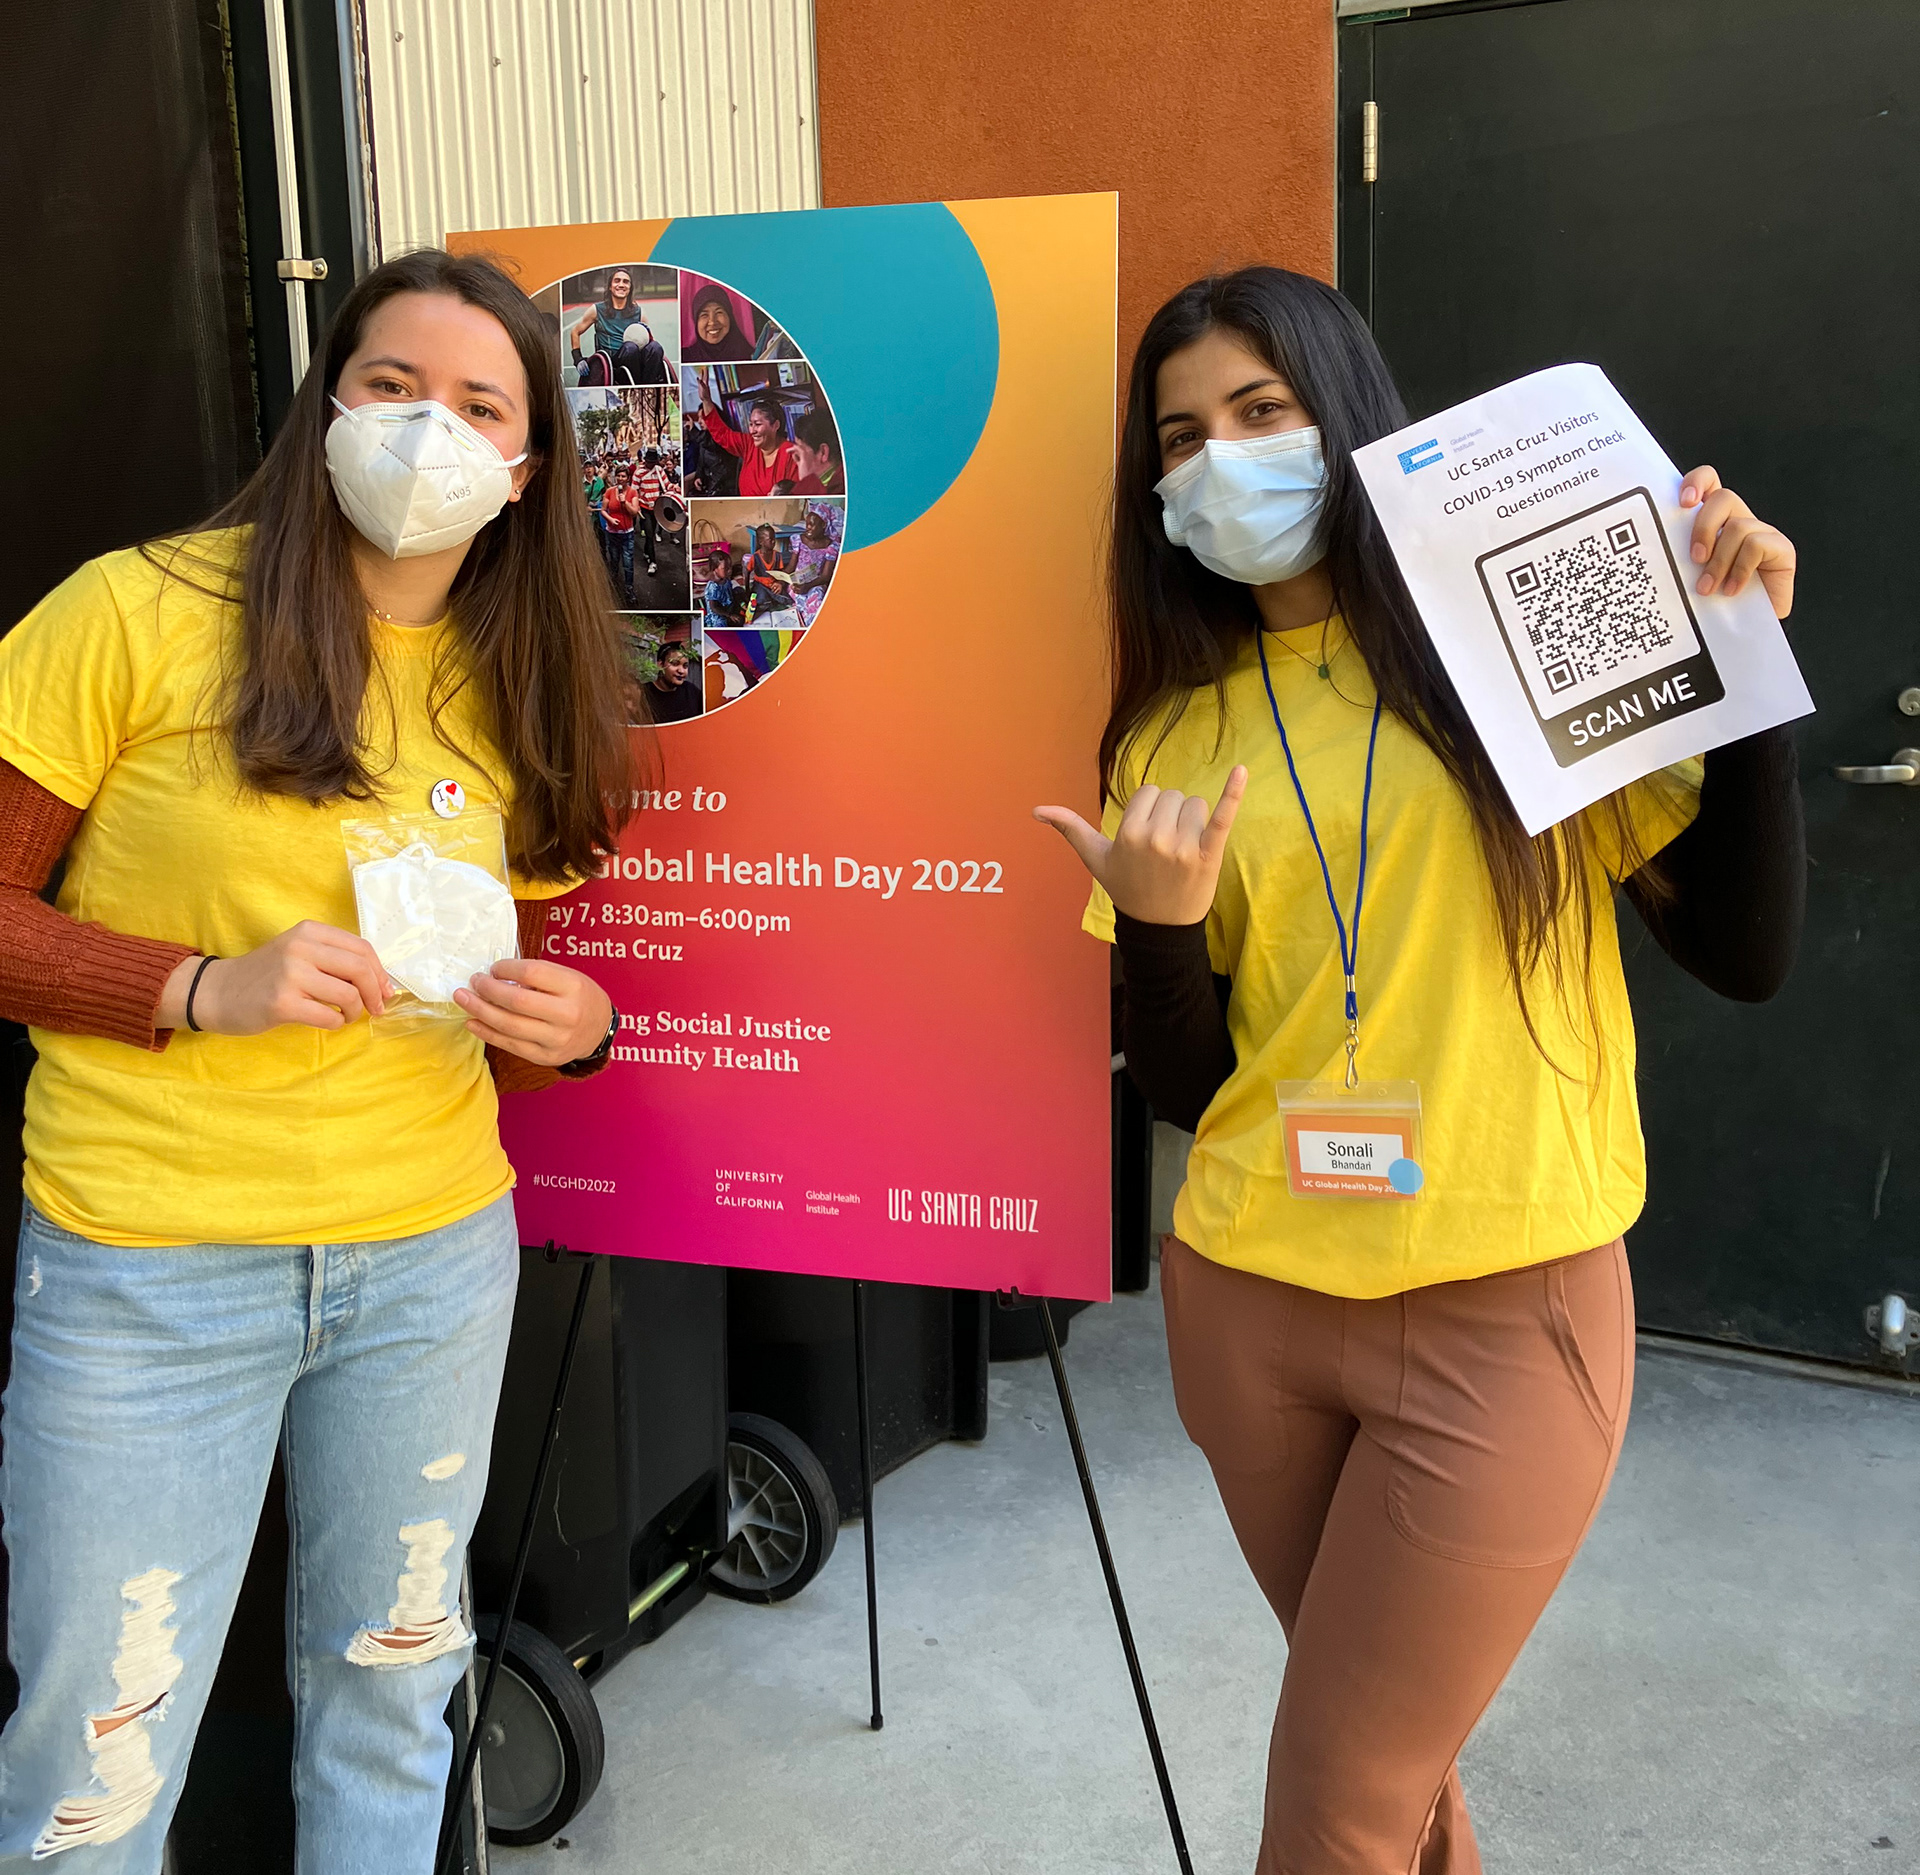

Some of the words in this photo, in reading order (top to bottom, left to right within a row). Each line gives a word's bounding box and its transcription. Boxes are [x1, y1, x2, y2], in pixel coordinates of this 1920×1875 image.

[1399, 440, 1438, 460] UNIVERSITY
[1447, 463, 1471, 481] UC
[1472, 447, 1514, 472] Santa
[1516, 431, 1549, 452] Cruz
[1548, 411, 1599, 437] Visitors
[1402, 459, 1411, 467] OF
[1405, 453, 1443, 474] CALIFORNIA
[1443, 475, 1515, 515] COVID-19
[1516, 447, 1586, 483] Symptom
[1587, 429, 1626, 452] Check
[445, 485, 471, 503] KN95
[1496, 467, 1600, 519] Questionnaire
[1568, 693, 1645, 747] SCAN
[1647, 672, 1697, 712] ME
[692, 786, 727, 812] to
[705, 852, 823, 888] Health
[834, 856, 903, 900] Day
[911, 858, 1004, 894] 2022
[546, 904, 575, 928] ay
[578, 902, 596, 927] 7,
[541, 934, 561, 956] C
[566, 935, 627, 959] Santa
[632, 938, 684, 962] Cruz
[656, 1010, 732, 1037] Social
[739, 1016, 832, 1042] Justice
[712, 1046, 800, 1073] Health
[1327, 1141, 1373, 1158] Sonali
[1331, 1160, 1371, 1171] Bhandari
[533, 1173, 616, 1194] #UCGHD2022
[715, 1169, 784, 1184] UNIVERSITY
[1302, 1180, 1314, 1188] UC
[1315, 1180, 1340, 1189] Global
[1341, 1182, 1367, 1191] Health
[1368, 1184, 1383, 1194] Day
[715, 1182, 731, 1193] OF
[805, 1190, 832, 1202] Global
[833, 1192, 861, 1204] Health
[715, 1195, 784, 1211] CALIFORNIA
[805, 1203, 840, 1216] Institute
[888, 1187, 913, 1223] UC
[920, 1190, 981, 1229] SANTA
[989, 1196, 1039, 1233] CRUZ
